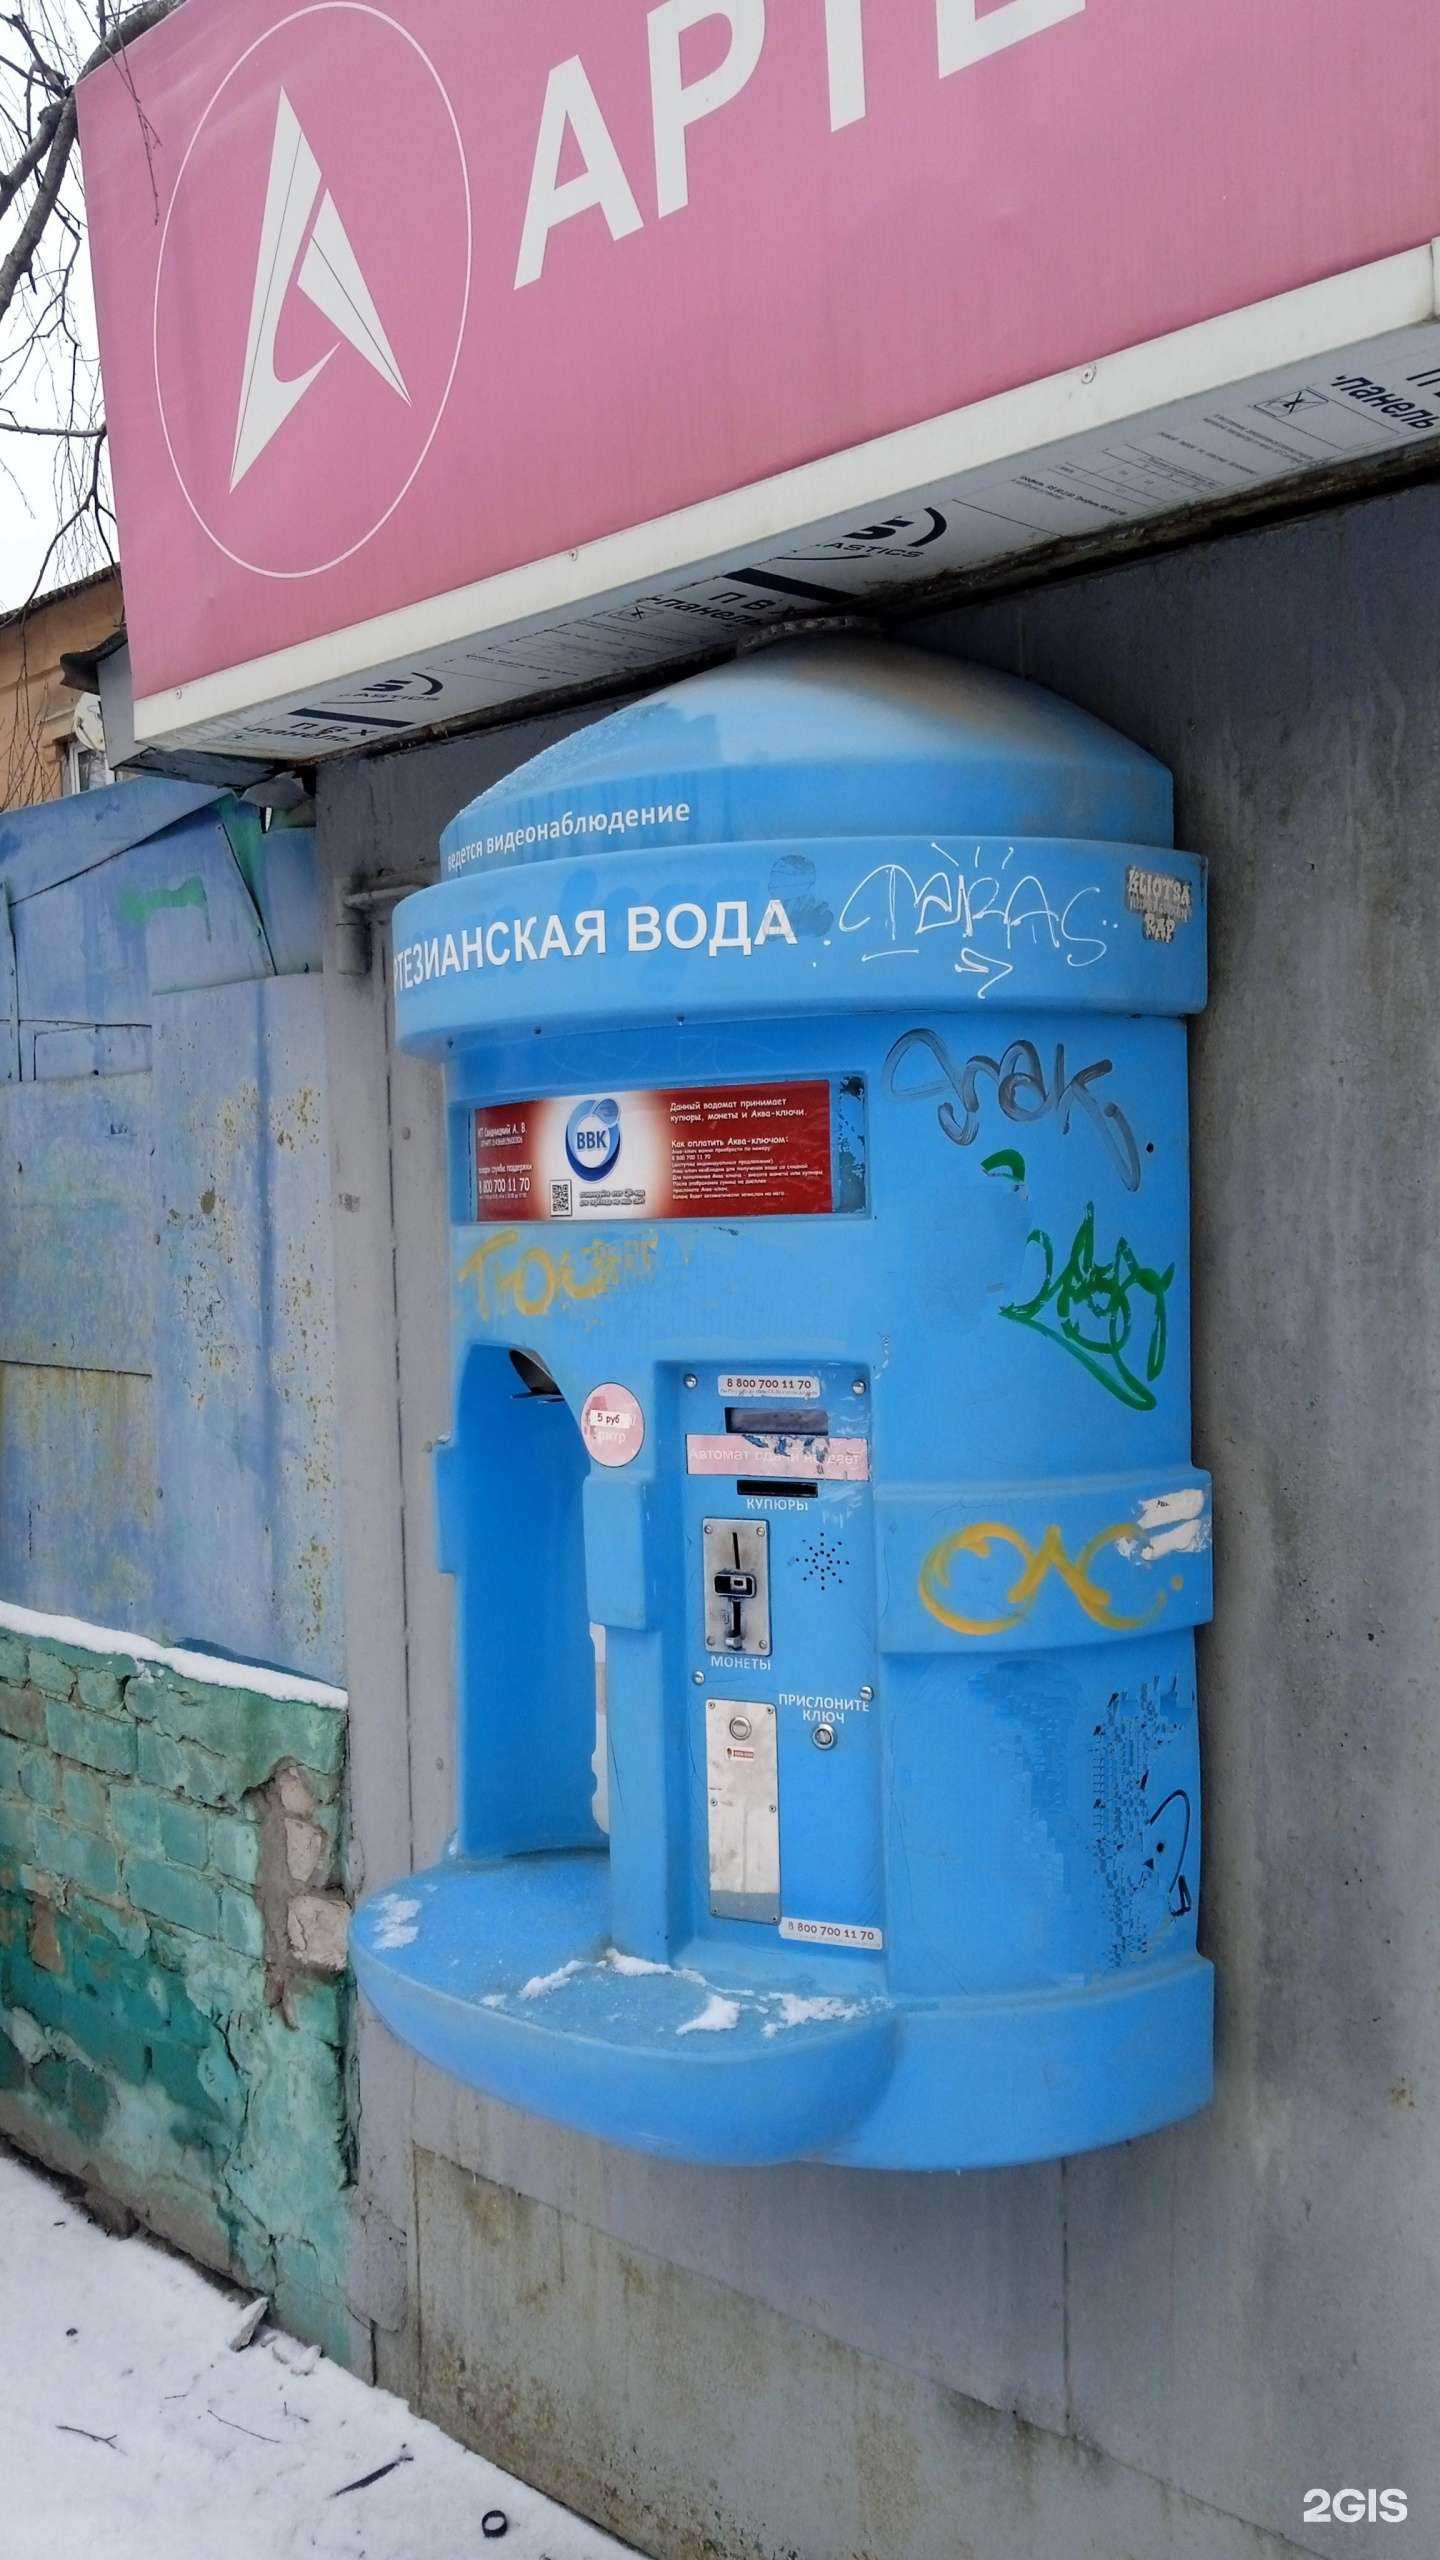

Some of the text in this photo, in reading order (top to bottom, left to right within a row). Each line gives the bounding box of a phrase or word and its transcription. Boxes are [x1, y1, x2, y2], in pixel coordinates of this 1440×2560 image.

[486, 802, 691, 855] видеонаблюдение
[627, 899, 798, 957] ВОДА
[670, 1099, 787, 1113] Данный водомат принимает
[670, 1114, 704, 1124] купюры,
[708, 1112, 738, 1121] монеты
[577, 1131, 607, 1150] ВВК
[672, 1136, 789, 1148] Как оплатить Аква-ключом:
[494, 1177, 506, 1193] 700
[508, 1176, 517, 1192] 11
[519, 1176, 530, 1192] 70
[736, 1378, 756, 1388] 800
[759, 1379, 779, 1390] 700
[782, 1380, 794, 1389] 11
[797, 1380, 811, 1390] 70
[597, 1412, 620, 1426] 5 руб
[747, 1498, 808, 1511] КУПЮРЫ
[711, 1655, 771, 1671] МОНЕТЫ
[778, 1693, 870, 1712] ПРИСЛОНИТЕ
[803, 1709, 845, 1723] КЛЮЧ
[797, 1922, 817, 1934] 800
[821, 1924, 841, 1937] 700
[844, 1928, 857, 1938] 11
[860, 1928, 874, 1941] 70
